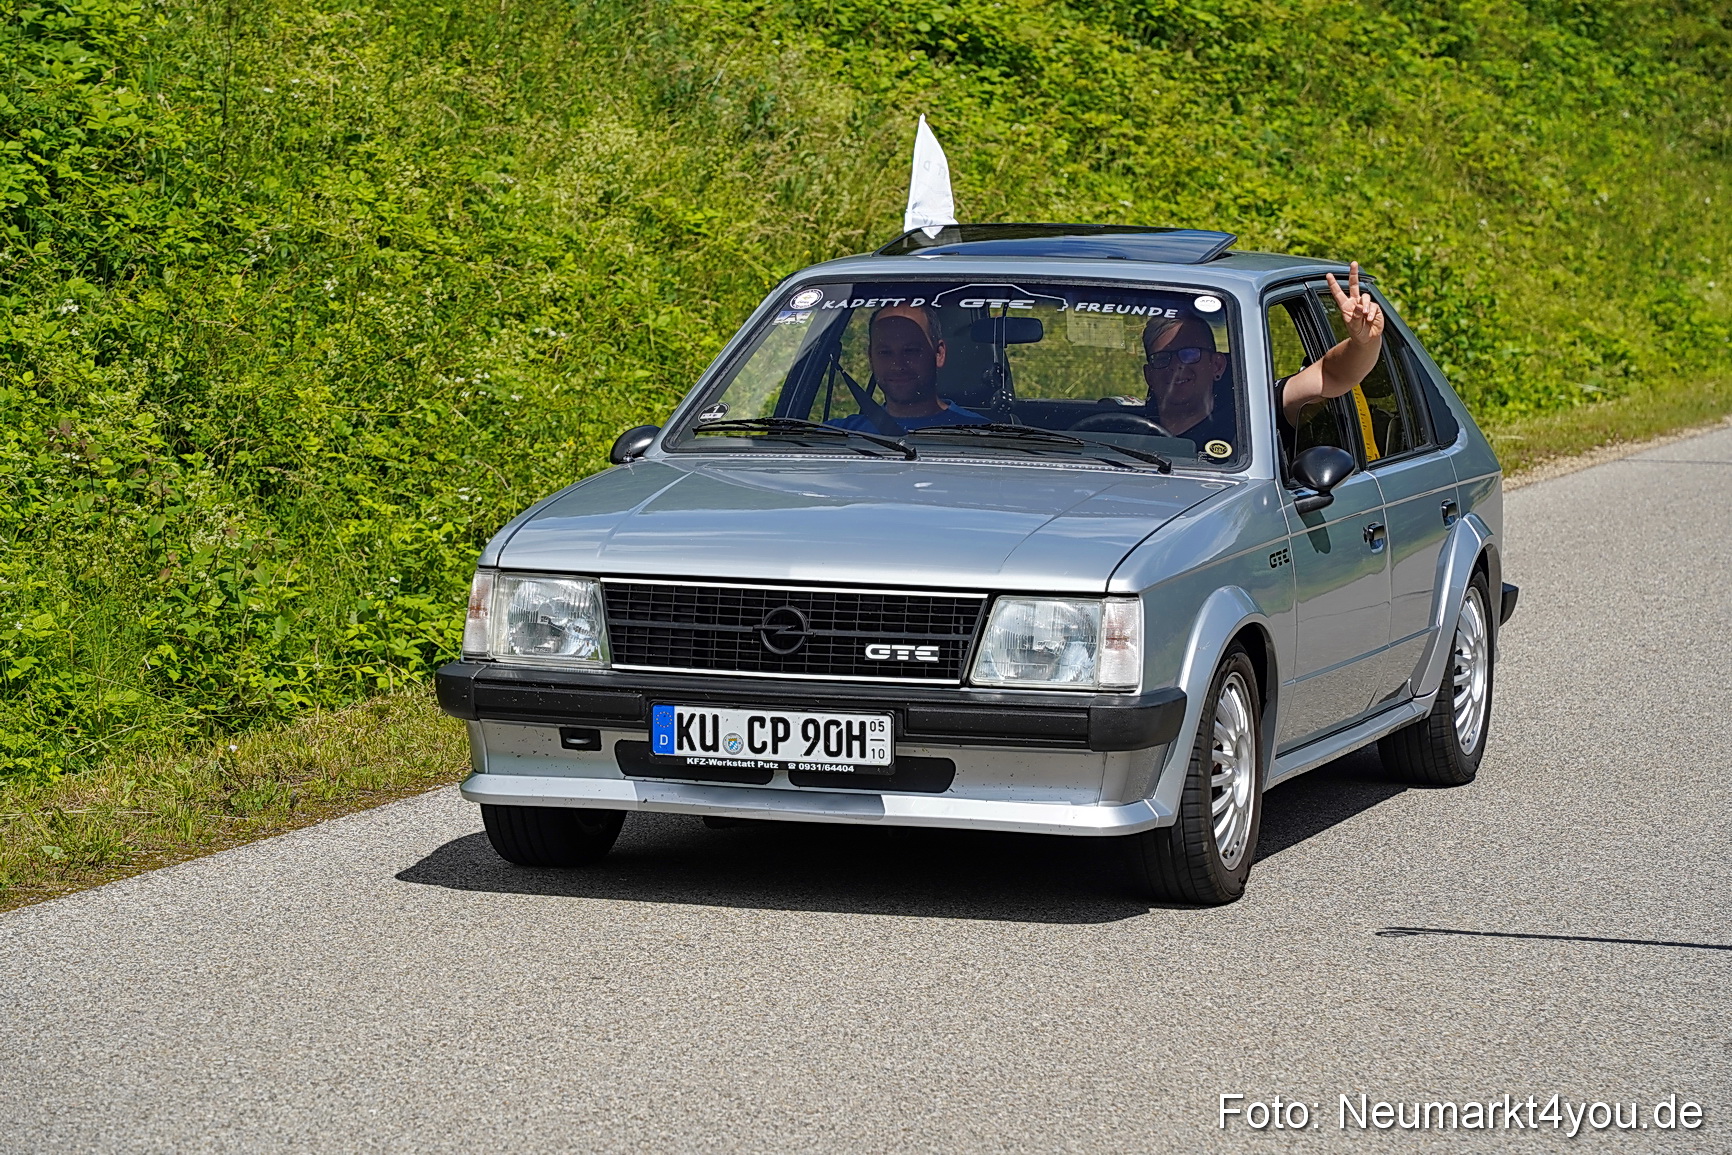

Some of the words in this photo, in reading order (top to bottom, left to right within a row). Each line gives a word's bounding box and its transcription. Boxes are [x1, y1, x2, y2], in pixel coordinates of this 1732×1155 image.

[822, 298, 906, 310] KADETT
[909, 298, 925, 308] D
[959, 298, 1035, 310] GTE
[1074, 302, 1179, 319] FREUNDE
[1269, 547, 1290, 569] GTE
[865, 643, 939, 661] GTE
[870, 720, 885, 732] 05
[659, 734, 669, 746] D
[676, 712, 720, 752] KU
[747, 715, 791, 755] CP
[801, 717, 867, 759] 90H
[871, 748, 885, 759] 10
[686, 757, 756, 768] KFZ-Werkstatt
[757, 761, 779, 769] Putz
[798, 763, 855, 772] 0931/64404
